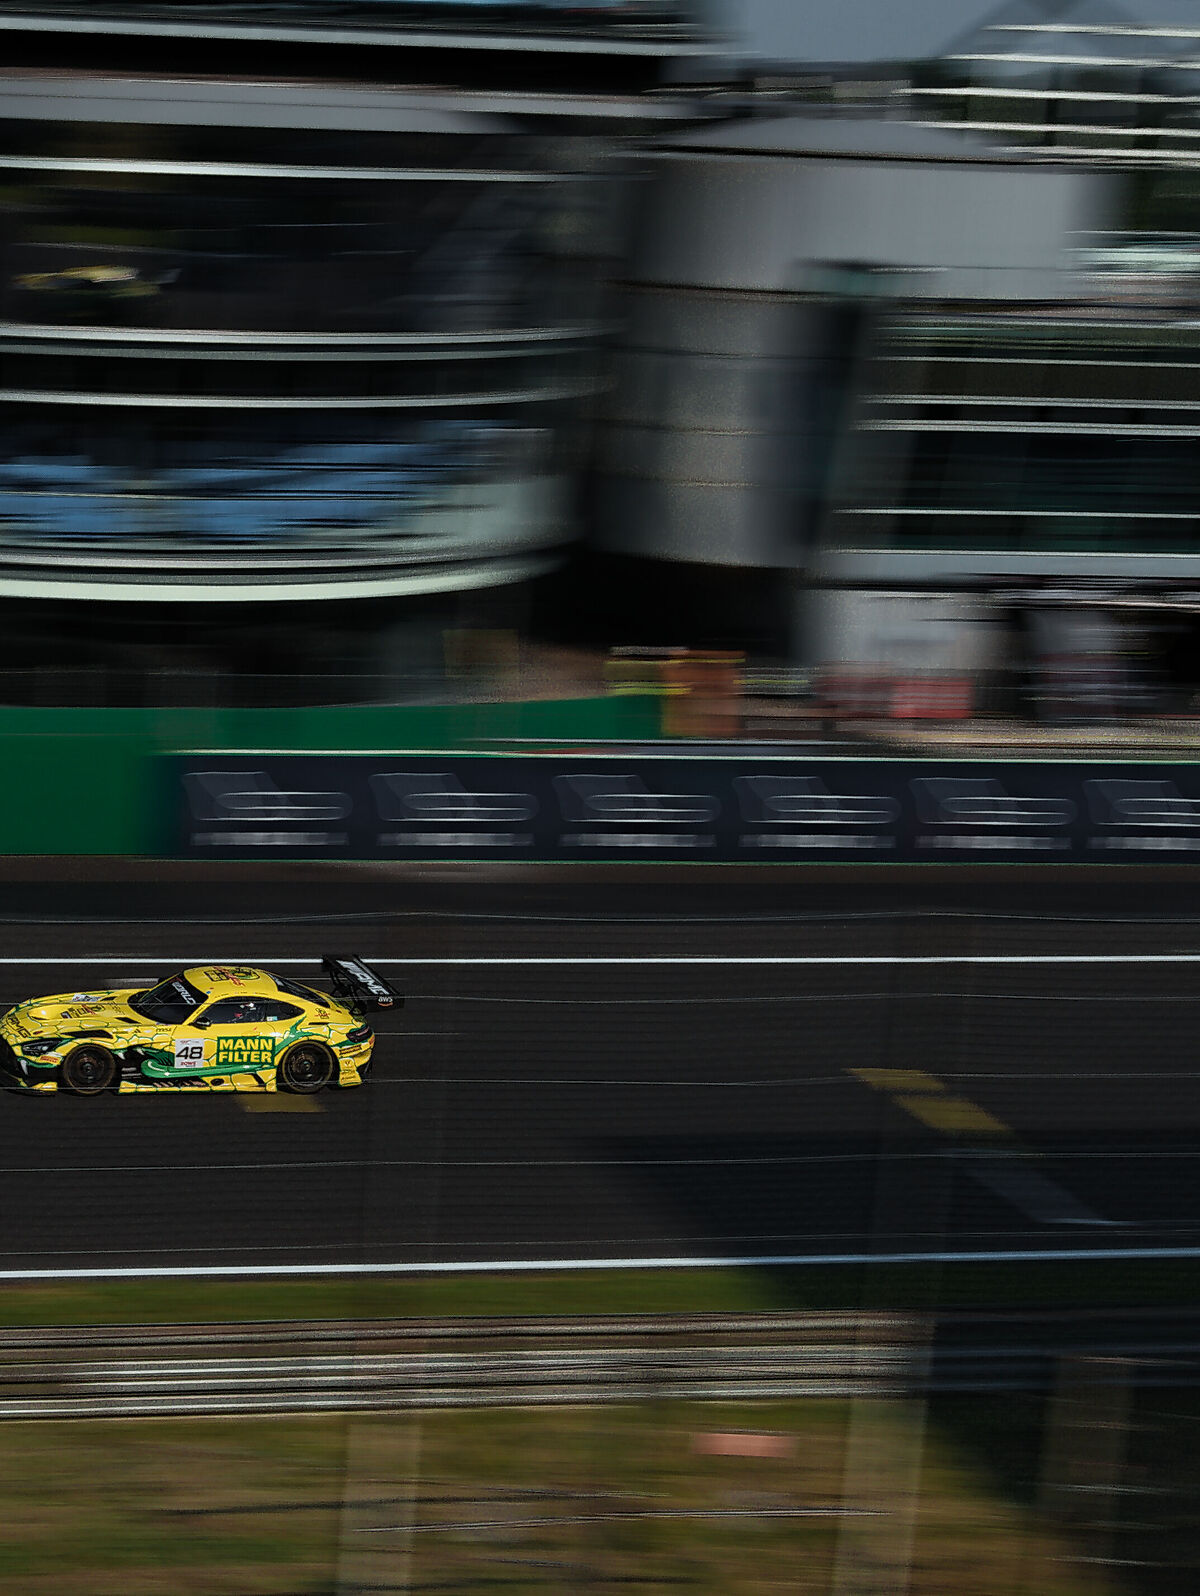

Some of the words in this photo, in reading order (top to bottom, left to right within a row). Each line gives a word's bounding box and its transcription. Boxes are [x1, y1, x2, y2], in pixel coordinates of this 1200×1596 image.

[219, 1038, 273, 1051] MANN
[176, 1046, 203, 1060] 48
[219, 1051, 272, 1063] FILTER
